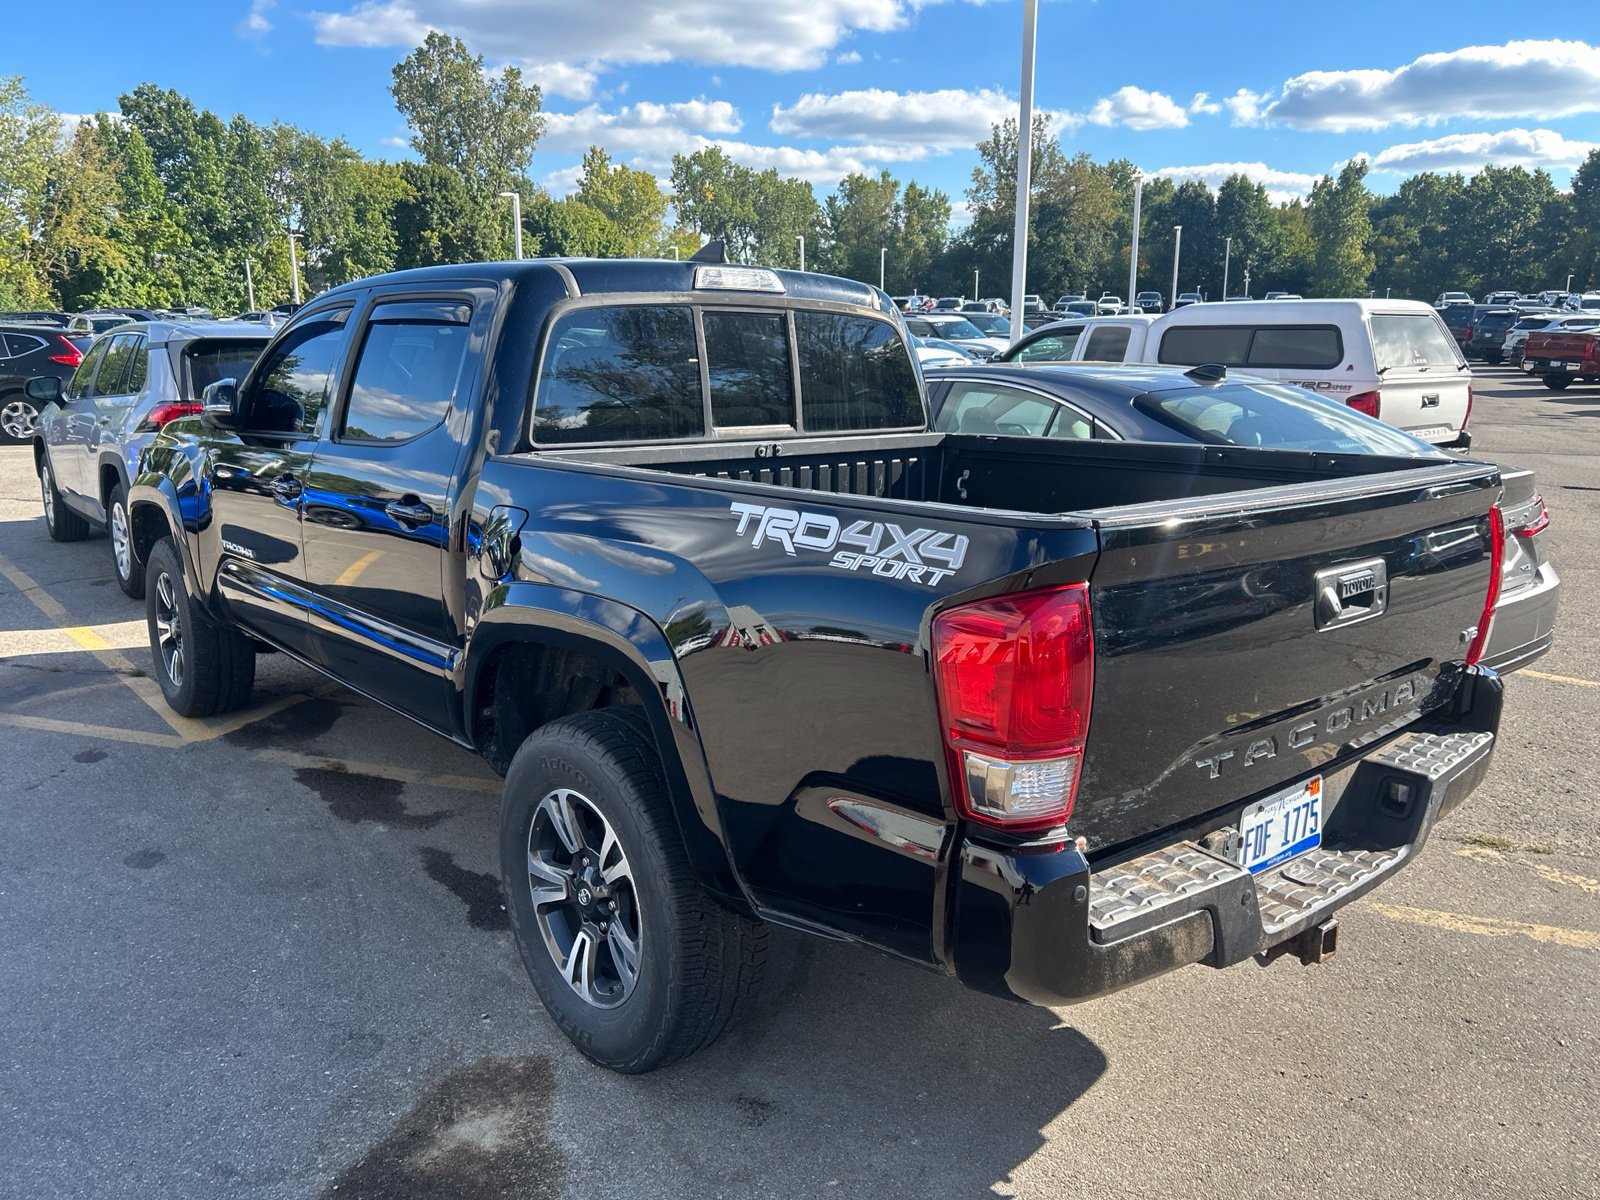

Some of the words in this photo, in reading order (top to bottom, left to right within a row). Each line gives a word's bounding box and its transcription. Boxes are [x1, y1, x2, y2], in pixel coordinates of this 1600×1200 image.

[1288, 381, 1332, 391] TRD
[730, 502, 840, 557] TRD
[221, 540, 254, 559] TACOMA
[829, 551, 955, 587] SPORT
[1343, 576, 1375, 595] TOYOTA
[1460, 626, 1478, 642] V6
[1196, 679, 1415, 779] TACOMA
[1242, 818, 1274, 866] FDF
[1281, 798, 1319, 848] 1775
